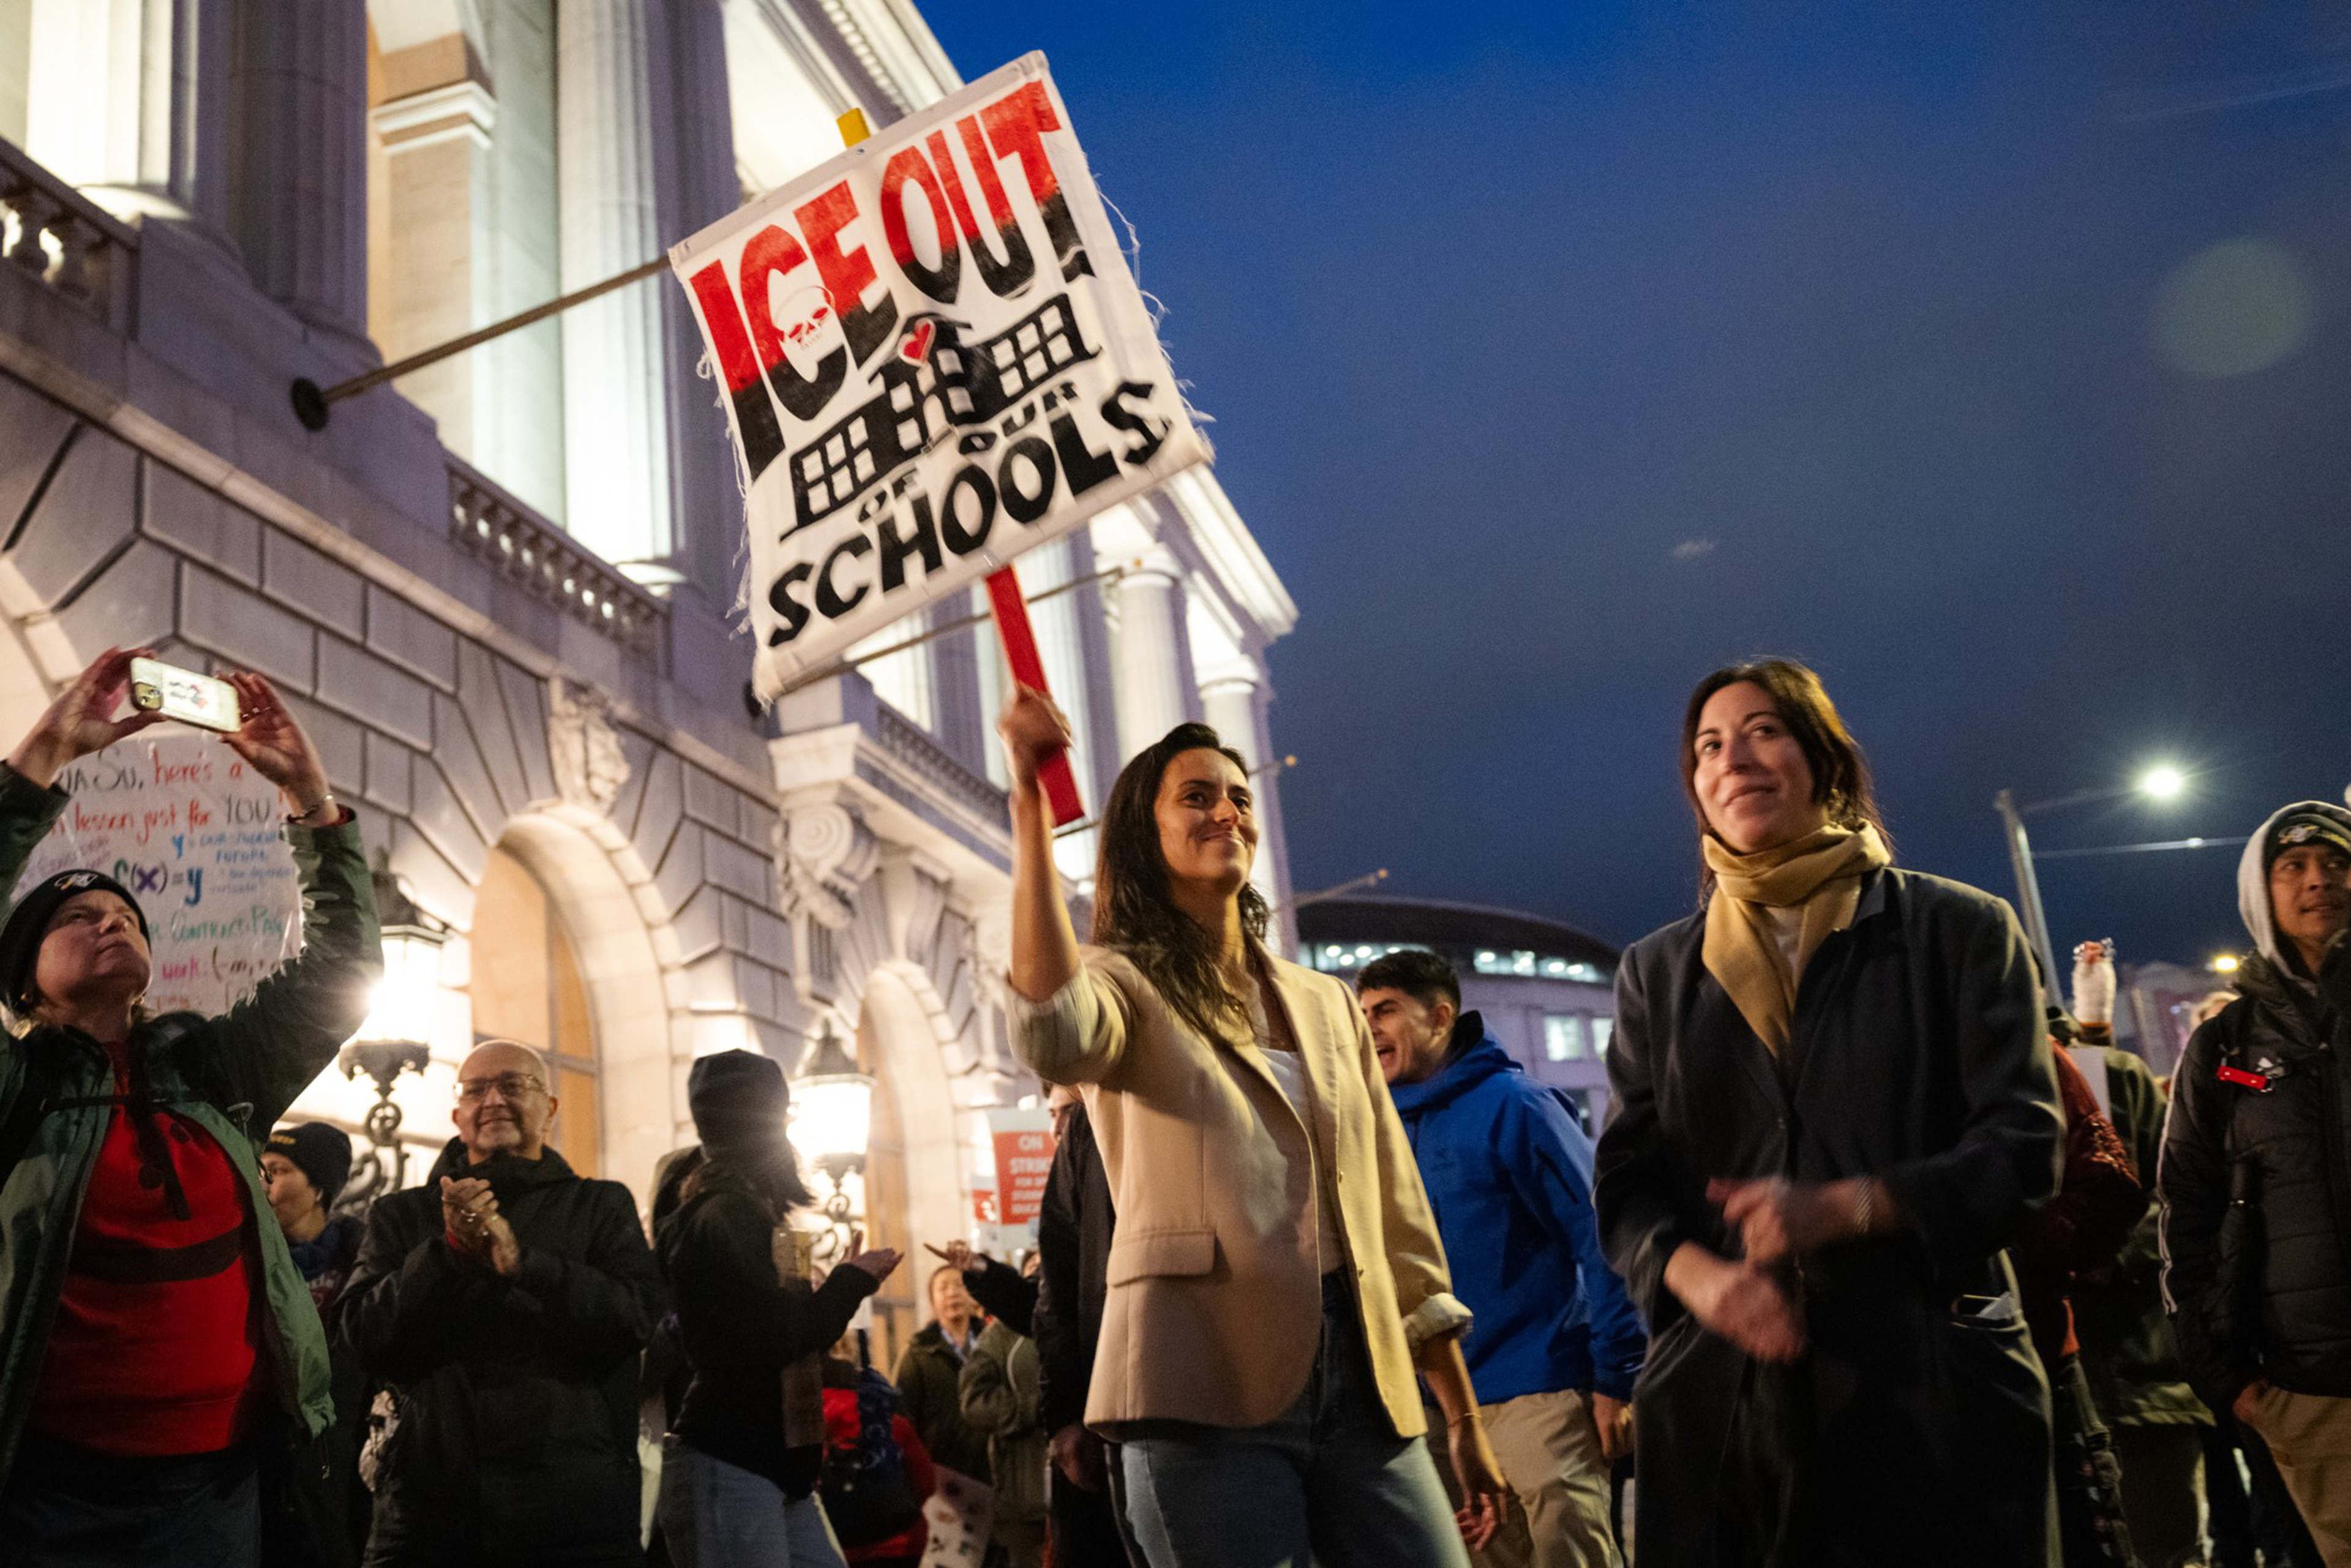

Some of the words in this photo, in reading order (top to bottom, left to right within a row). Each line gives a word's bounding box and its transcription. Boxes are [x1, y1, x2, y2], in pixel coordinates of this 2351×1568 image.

[689, 179, 899, 482] ICE
[880, 80, 1095, 305] OUT
[857, 467, 927, 523] OF
[959, 381, 1079, 455] OUR
[768, 380, 1173, 648] SCHOOLS
[229, 763, 242, 779] a
[136, 803, 182, 844] just
[189, 799, 210, 834] for
[1018, 1135, 1043, 1150] ON
